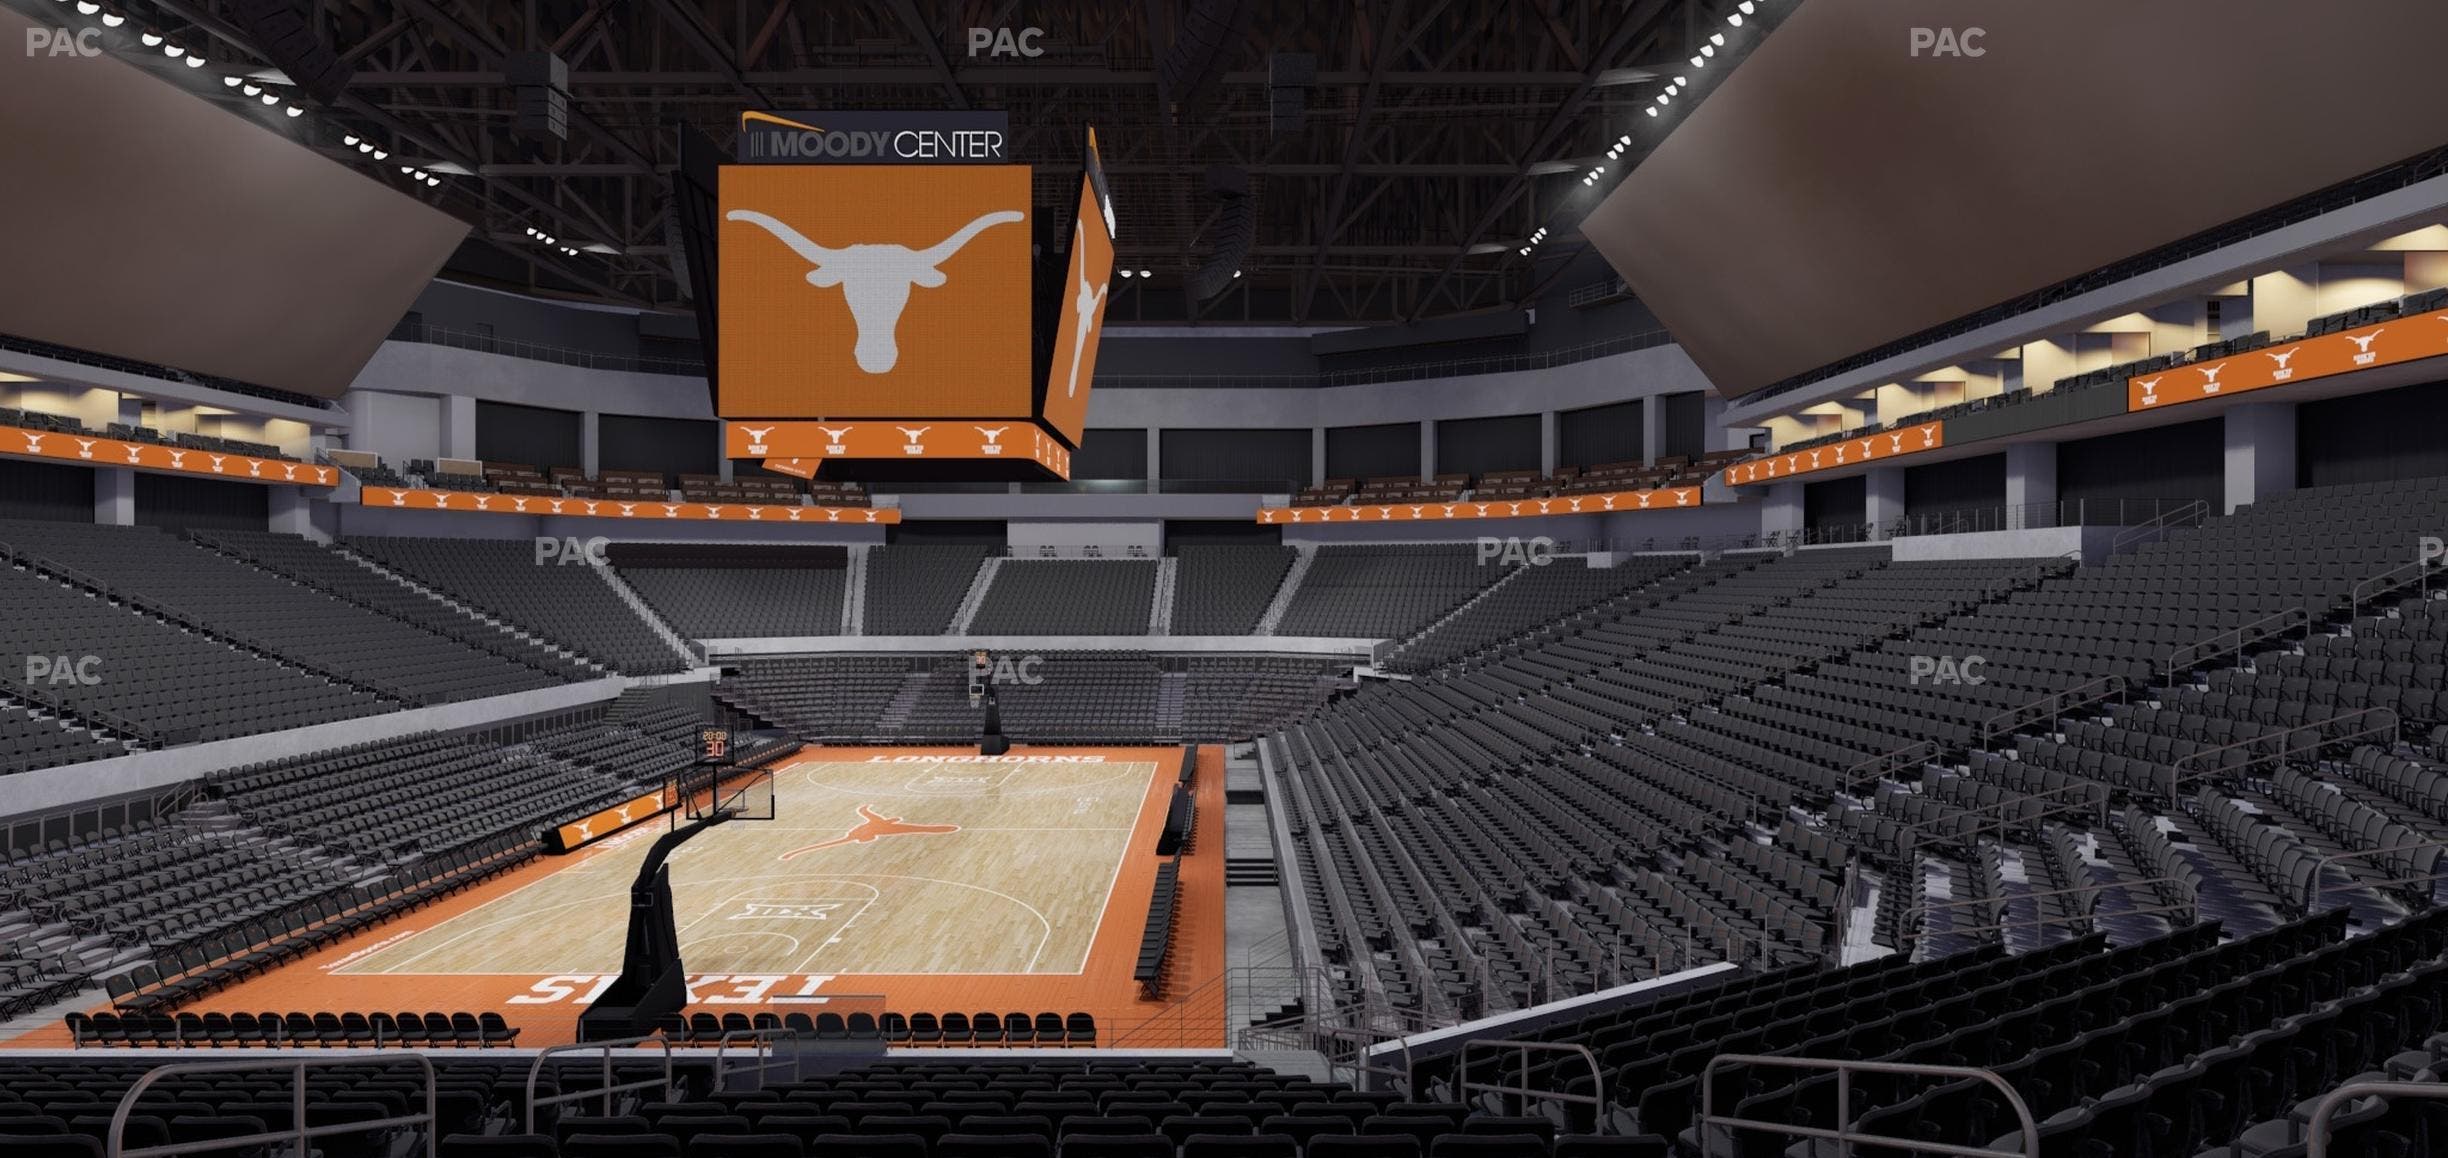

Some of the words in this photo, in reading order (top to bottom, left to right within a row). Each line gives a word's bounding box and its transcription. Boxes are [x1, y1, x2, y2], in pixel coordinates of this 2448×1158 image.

[771, 131, 890, 157] MOODY
[894, 130, 1003, 158] CENTER
[866, 755, 1106, 764] LONGHORNS
